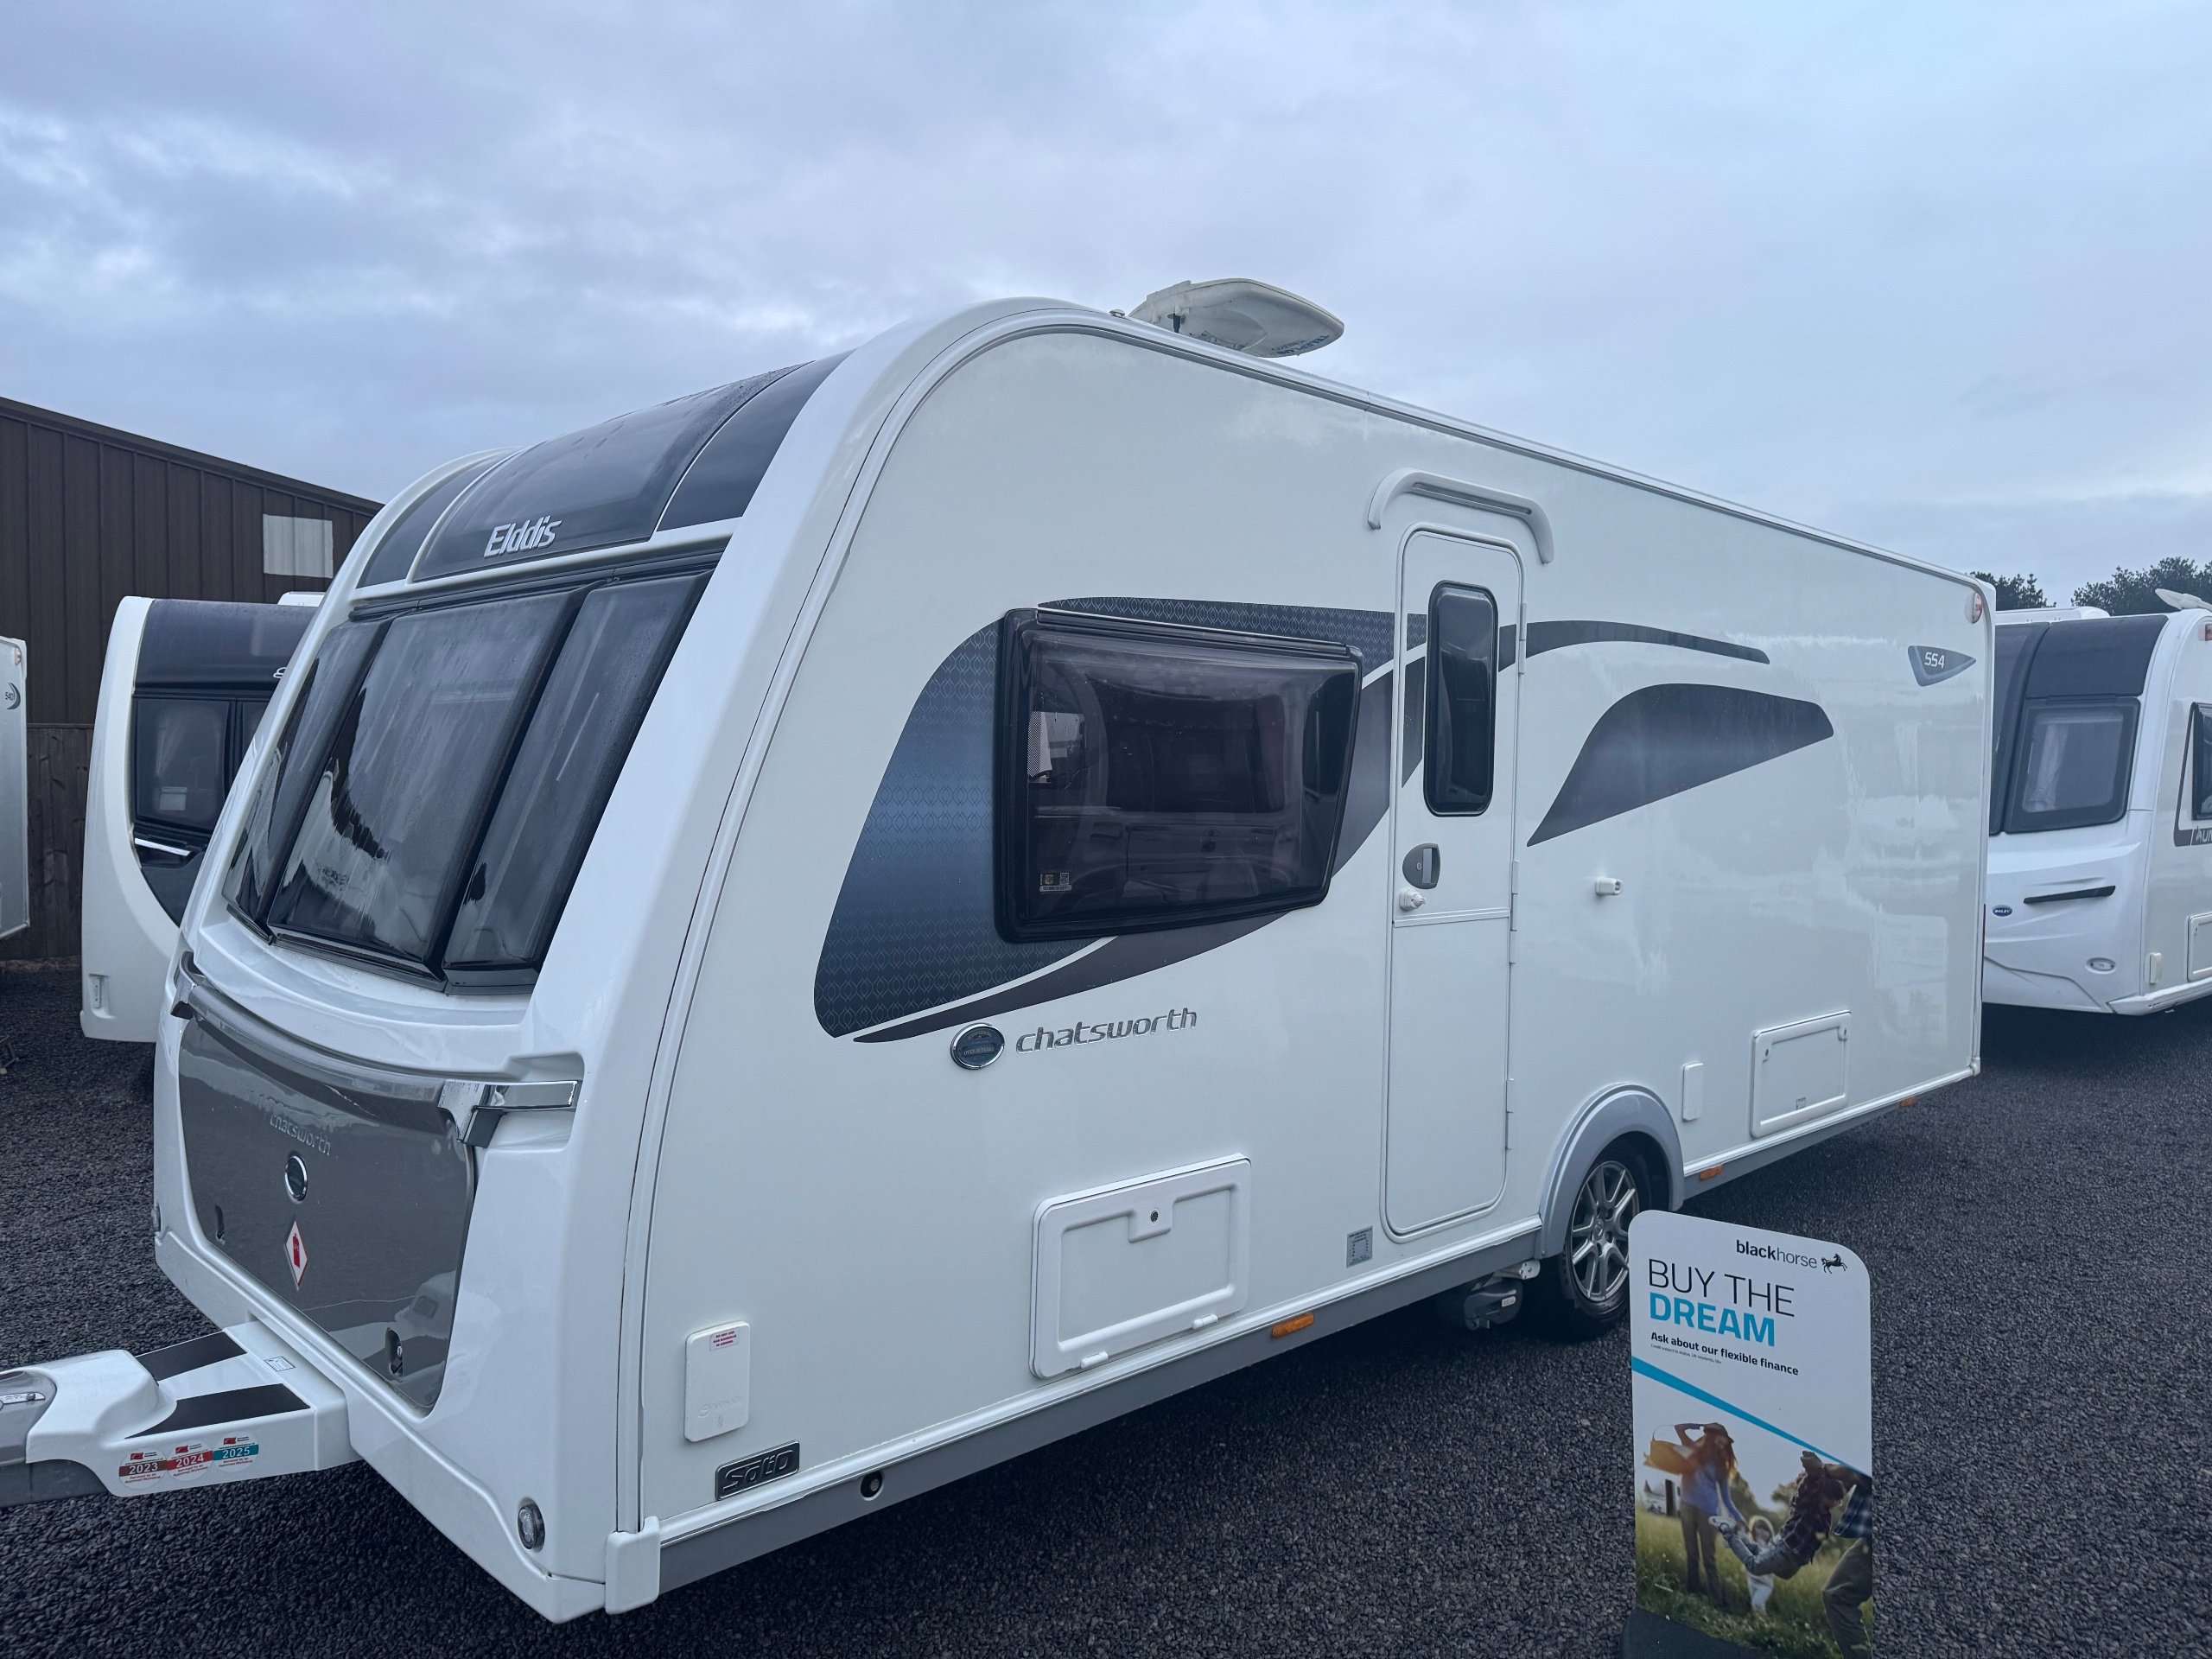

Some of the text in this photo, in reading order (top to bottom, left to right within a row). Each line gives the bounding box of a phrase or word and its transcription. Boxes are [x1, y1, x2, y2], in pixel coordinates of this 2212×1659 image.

[484, 515, 563, 558] Elddis
[1924, 652, 1945, 669] 554
[1015, 1007, 1198, 1054] chatsworth
[1736, 1239, 1817, 1268] blackhorse
[1649, 1259, 1795, 1318] BUY THE
[1649, 1292, 1775, 1347] DREAM
[1651, 1332, 1799, 1376] Ask about our flexible finance
[129, 1462, 158, 1475] 2023
[175, 1454, 204, 1468] 2024
[222, 1446, 251, 1459] 2025
